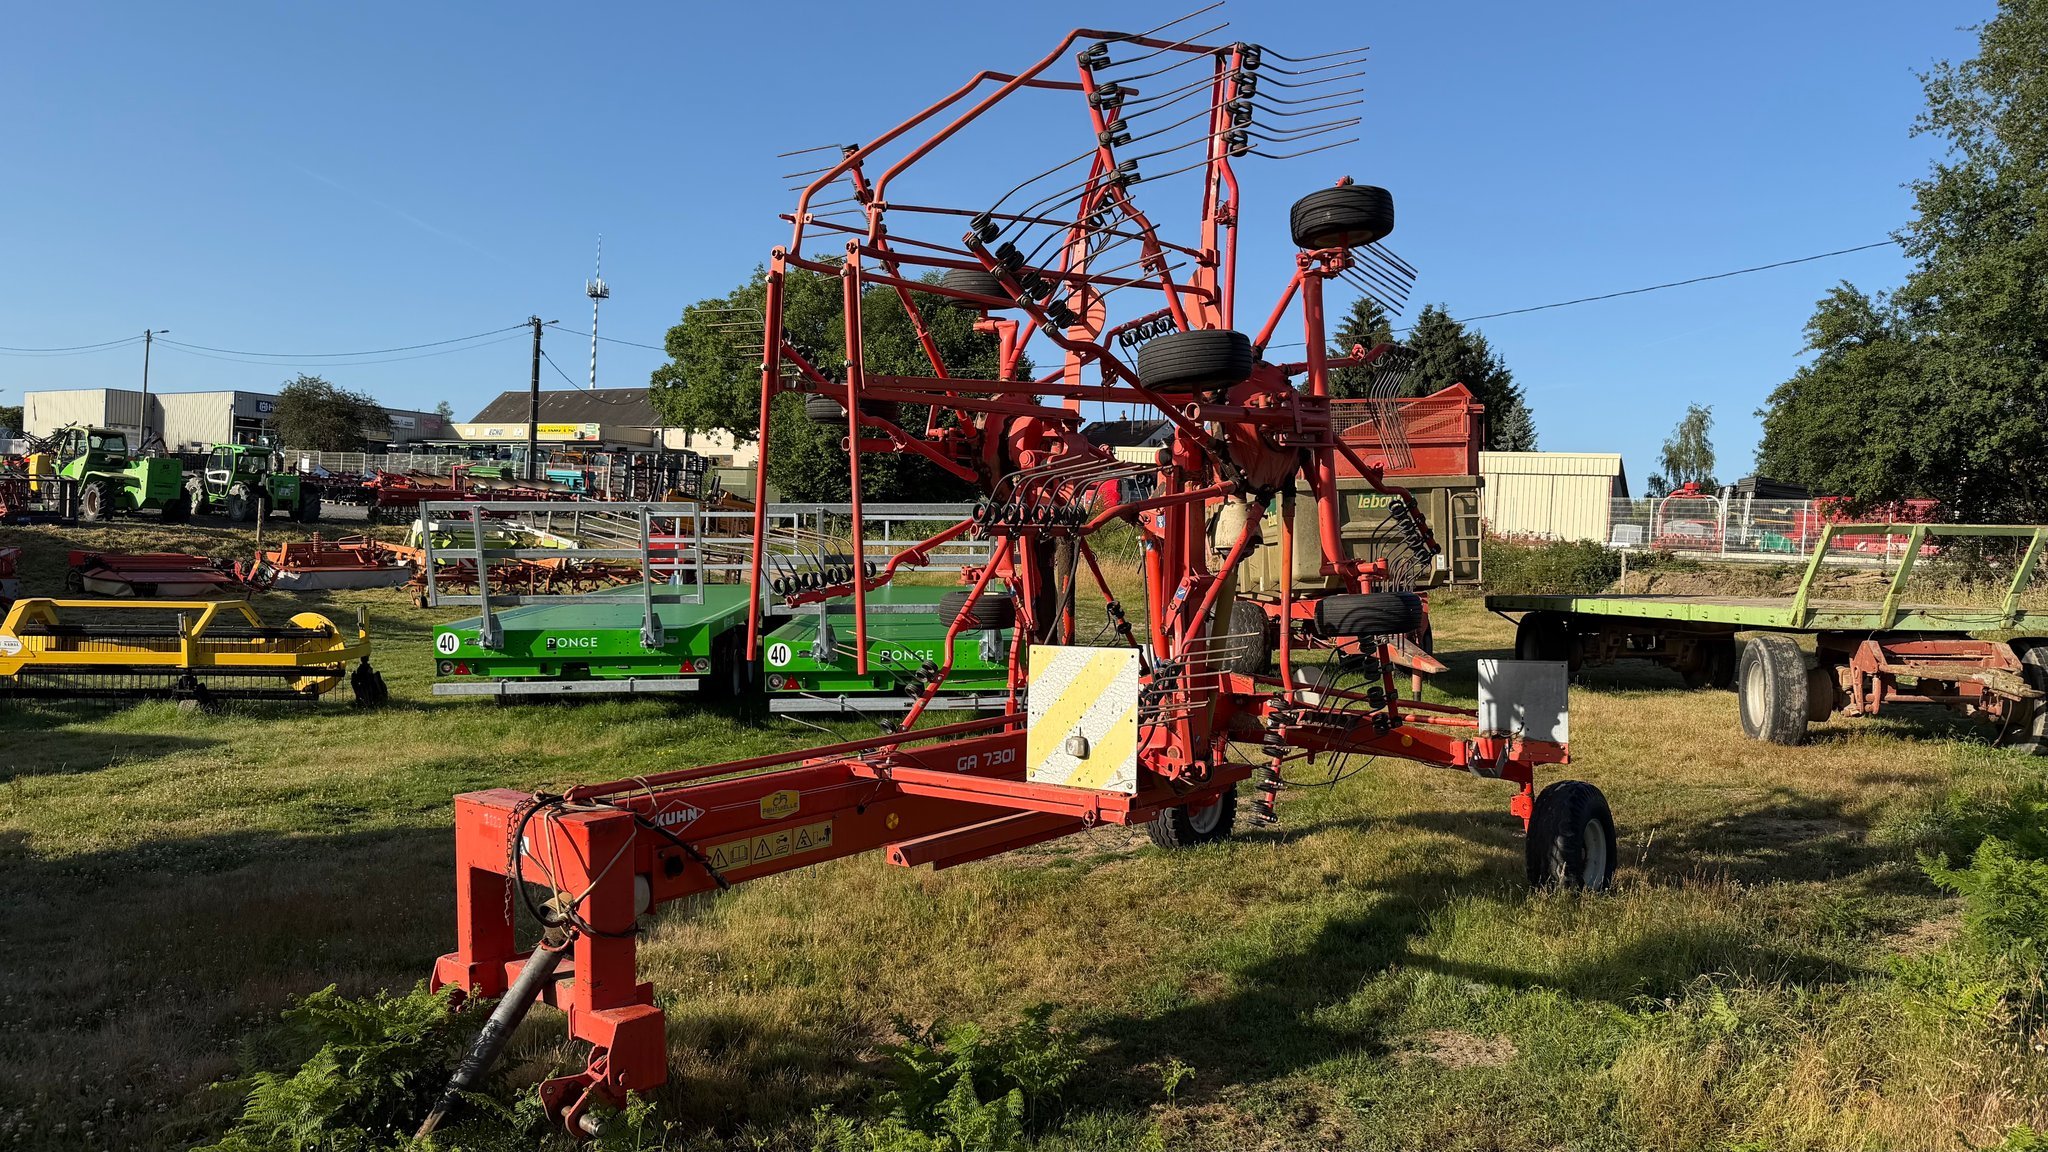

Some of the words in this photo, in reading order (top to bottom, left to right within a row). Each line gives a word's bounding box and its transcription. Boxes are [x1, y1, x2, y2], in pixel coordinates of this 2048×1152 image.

[439, 634, 455, 652] 40
[547, 637, 598, 648] PONGE
[770, 645, 786, 664] 40
[881, 650, 934, 661] PONGE
[957, 754, 978, 771] GA
[983, 748, 1016, 766] 7301
[655, 807, 698, 827] KUHN
